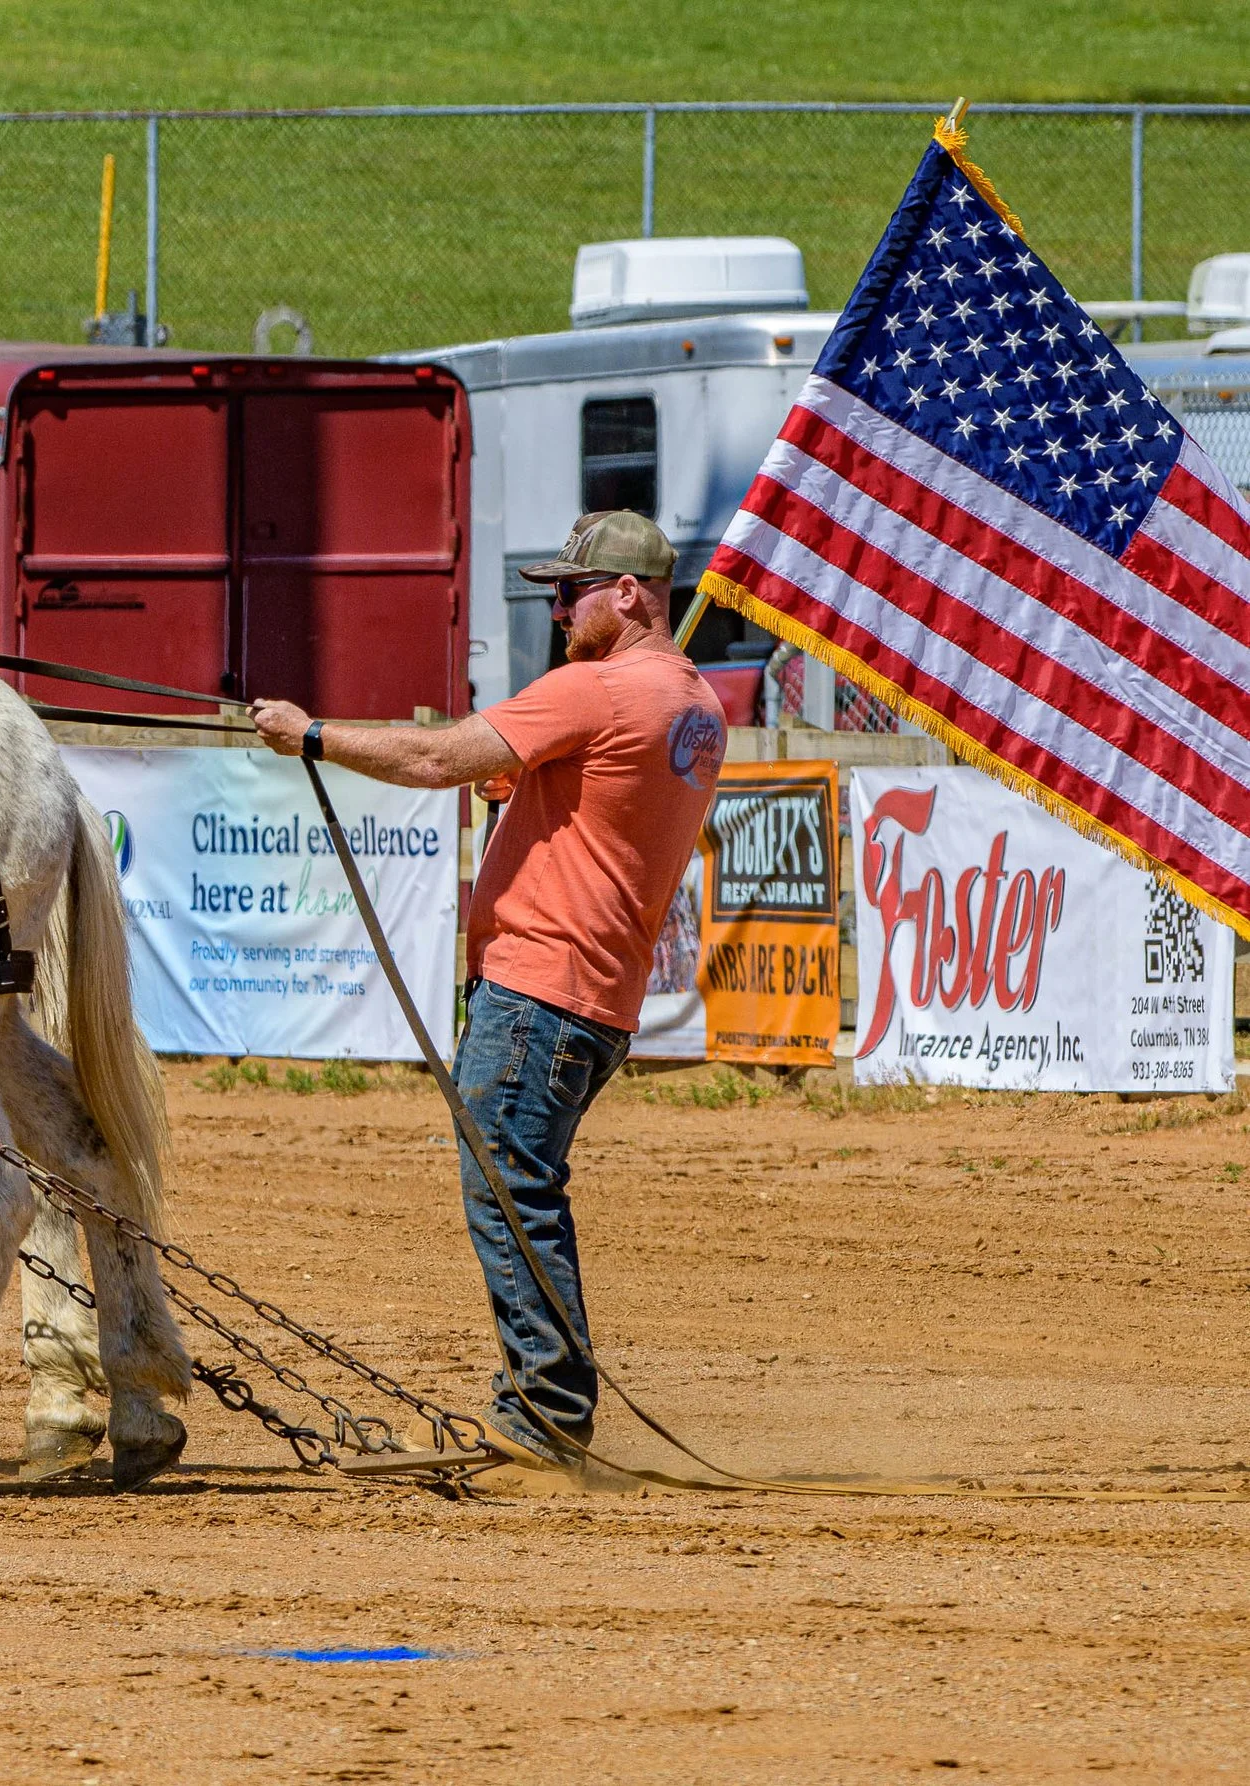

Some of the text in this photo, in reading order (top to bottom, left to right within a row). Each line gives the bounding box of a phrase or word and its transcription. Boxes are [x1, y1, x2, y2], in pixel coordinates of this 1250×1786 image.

[670, 704, 718, 776] Costa
[192, 812, 299, 857] Clinical
[713, 797, 823, 876] PUCKETT'S
[125, 899, 174, 919] IONAL
[190, 872, 253, 913] here
[260, 879, 290, 913] at
[720, 881, 825, 905] RESTAURANT
[855, 784, 1066, 1059] Foster
[191, 940, 239, 967] Proudly
[244, 944, 291, 968] serving
[294, 943, 316, 961] and
[707, 942, 747, 992] RIBS
[749, 943, 776, 994] ARE
[189, 973, 366, 999] our community for 70+ years
[1131, 996, 1149, 1014] 204
[1150, 996, 1159, 1014] W
[1177, 994, 1205, 1014] Street
[976, 1021, 1052, 1073] Agency,
[1056, 1021, 1084, 1063] Inc.
[1130, 1027, 1182, 1051] Columbia,
[1184, 1027, 1195, 1046] TN
